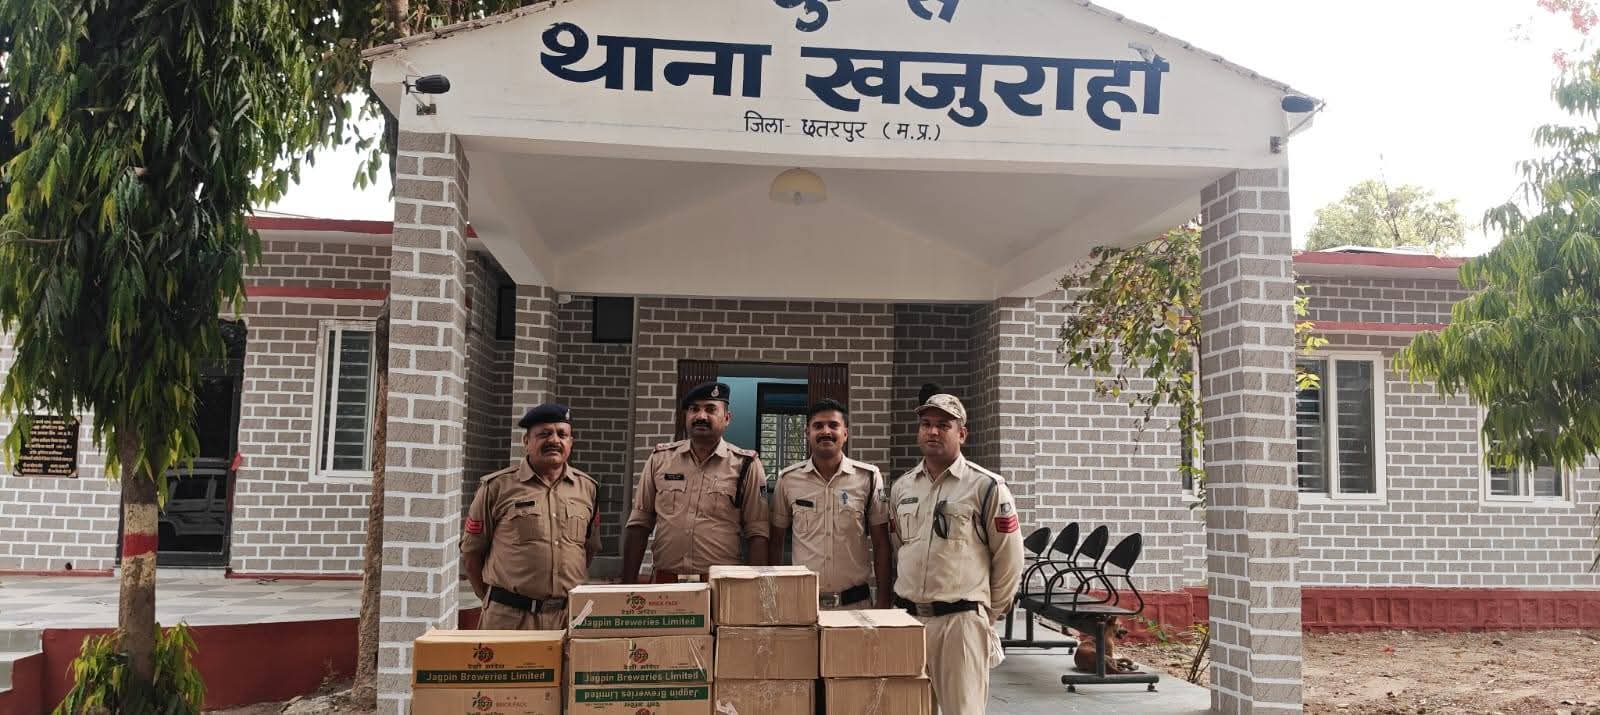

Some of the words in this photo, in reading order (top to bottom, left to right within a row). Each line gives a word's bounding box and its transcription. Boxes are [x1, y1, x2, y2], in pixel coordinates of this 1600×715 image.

[540, 22, 772, 98] थाना
[801, 118, 868, 143] छतरपुर
[582, 618, 612, 629] Jagpin
[615, 617, 660, 627] Breweries
[662, 616, 695, 626] Limited
[426, 671, 458, 682] Jagpin
[461, 671, 508, 681] Breweries
[511, 670, 545, 680] Limited
[584, 674, 615, 683] Jagpin
[617, 673, 662, 681] Breweries
[665, 671, 699, 680] Limited
[584, 690, 619, 700] Limited
[621, 689, 667, 699] Breweries
[670, 688, 699, 698] Jagpin
